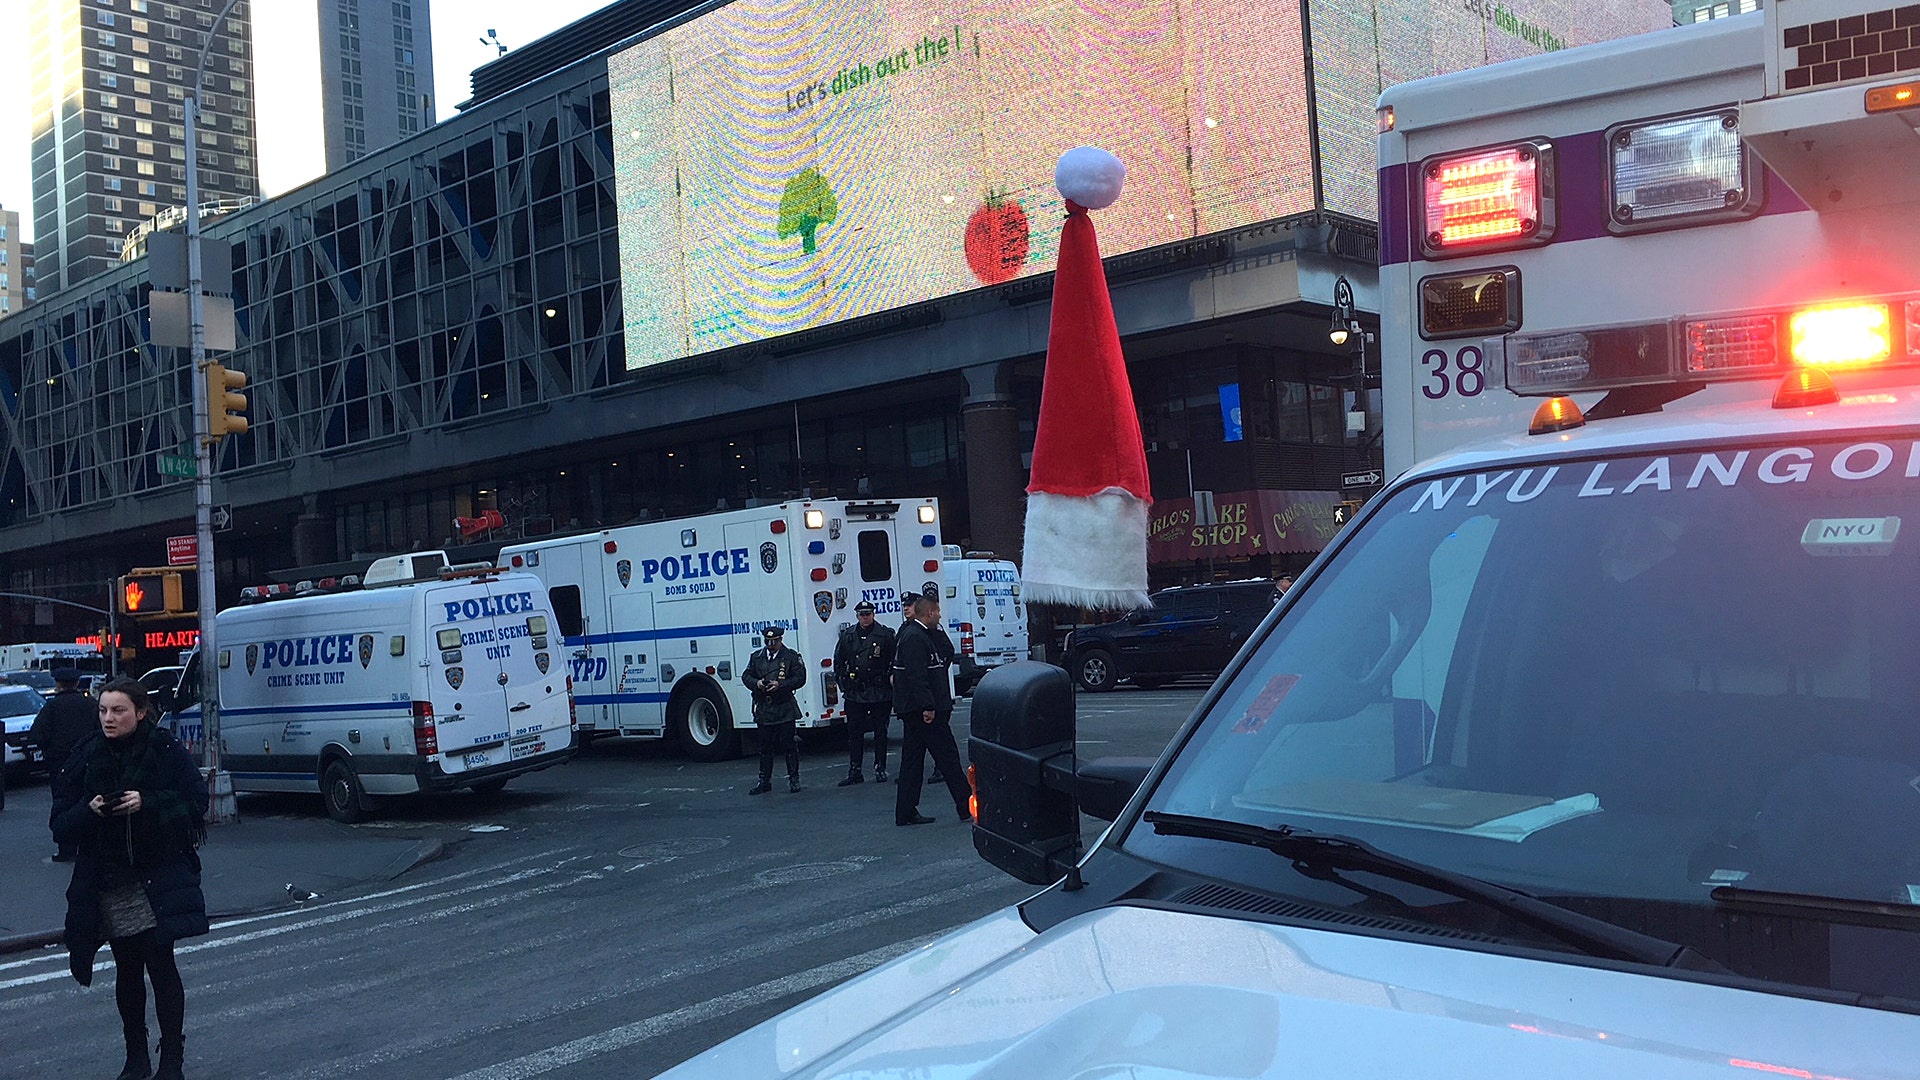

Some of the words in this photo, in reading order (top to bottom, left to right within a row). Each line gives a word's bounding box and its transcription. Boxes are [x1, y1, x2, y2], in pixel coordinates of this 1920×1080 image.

[786, 81, 827, 113] Let's
[832, 62, 870, 95] dish
[876, 48, 909, 78] out
[914, 35, 949, 65] the
[1422, 346, 1484, 399] 38
[175, 458, 188, 475] 42
[1409, 466, 1559, 513] NYU
[1578, 443, 1920, 498] LANGO
[1190, 523, 1248, 547] SHOP
[1822, 524, 1876, 538] NYU
[641, 548, 750, 584] POLICE
[977, 570, 1015, 582] POLICE
[665, 586, 687, 596] BOMB
[690, 582, 716, 595] SQUAD
[862, 587, 895, 602] NYPD
[444, 592, 534, 622] POLICE
[874, 600, 901, 615] LICE
[145, 630, 201, 648] HEART
[461, 629, 494, 646] CRIME
[498, 624, 530, 640] SCENE
[262, 633, 354, 669] POLICE
[486, 645, 511, 661] UNIT
[567, 656, 608, 683] YPD
[267, 674, 292, 688] CRIME
[295, 672, 321, 686] SCENE
[324, 671, 345, 684] UNIT
[180, 724, 202, 741] NYP
[474, 735, 492, 744] KEEP
[493, 732, 510, 741] BACK
[516, 728, 527, 736] 200
[528, 724, 543, 733] FEET
